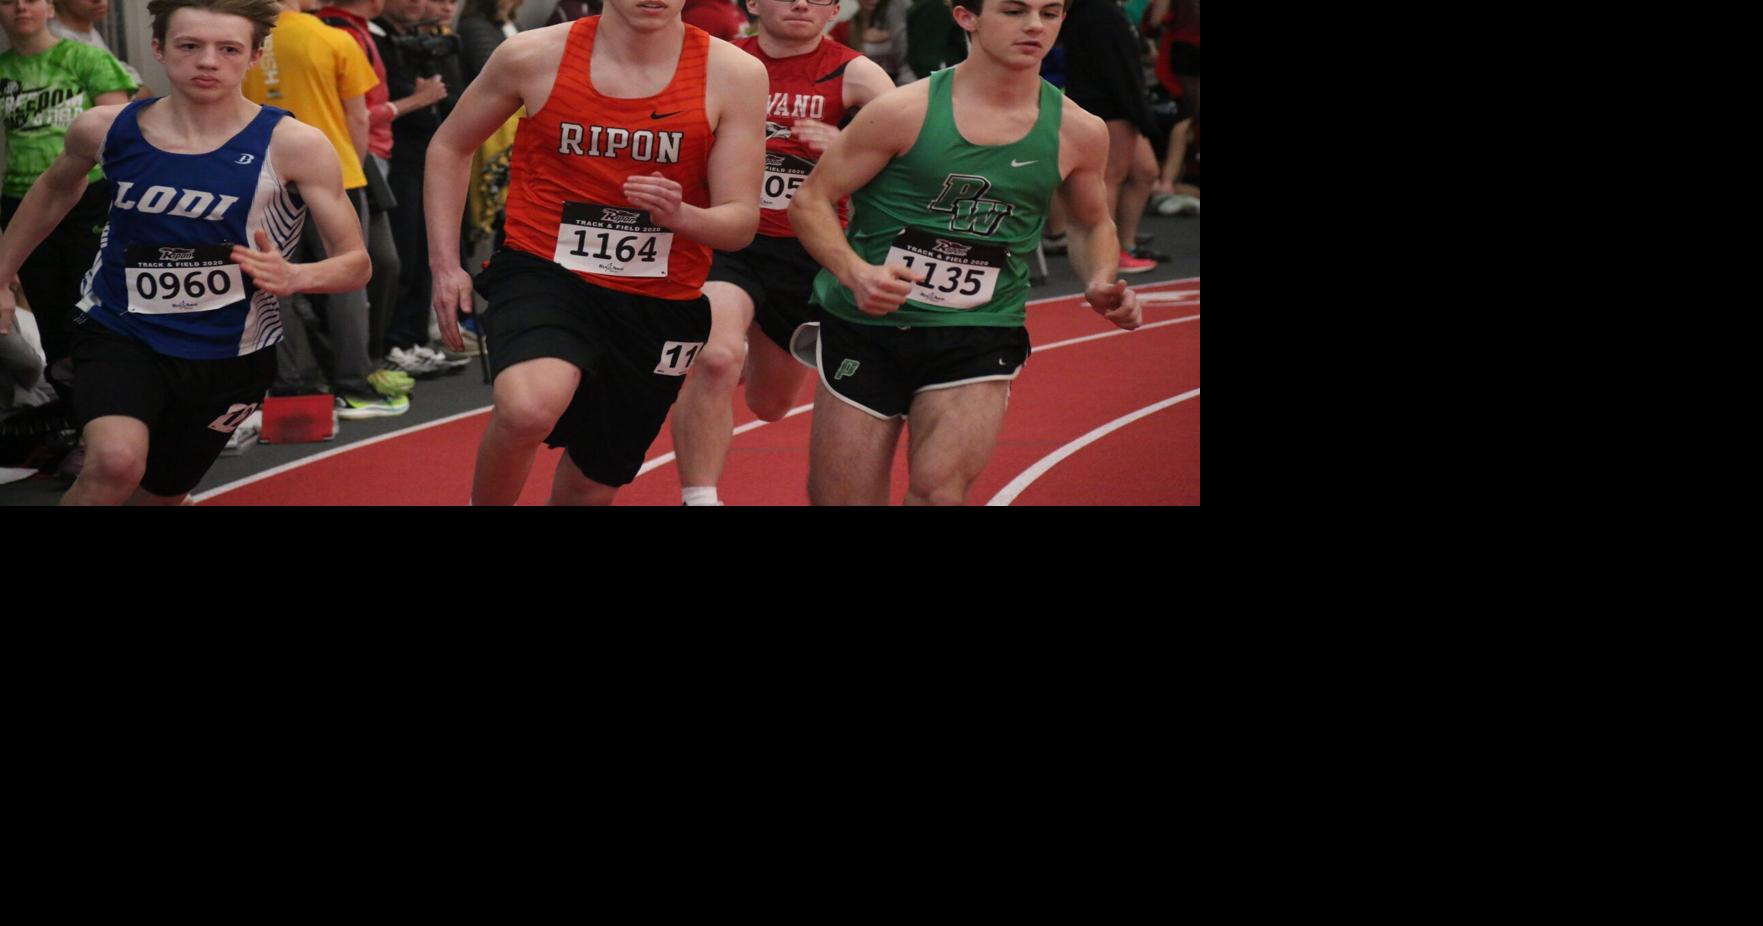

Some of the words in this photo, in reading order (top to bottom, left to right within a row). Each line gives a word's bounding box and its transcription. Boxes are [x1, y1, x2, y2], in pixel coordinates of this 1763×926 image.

[558, 121, 684, 163] RIPON
[114, 181, 240, 221] LODI
[576, 219, 604, 228] TRACK
[616, 224, 640, 232] FIELD
[569, 229, 657, 262] 1164
[906, 245, 934, 257] TRACK
[945, 256, 969, 264] FIELD
[136, 269, 231, 300] 0960
